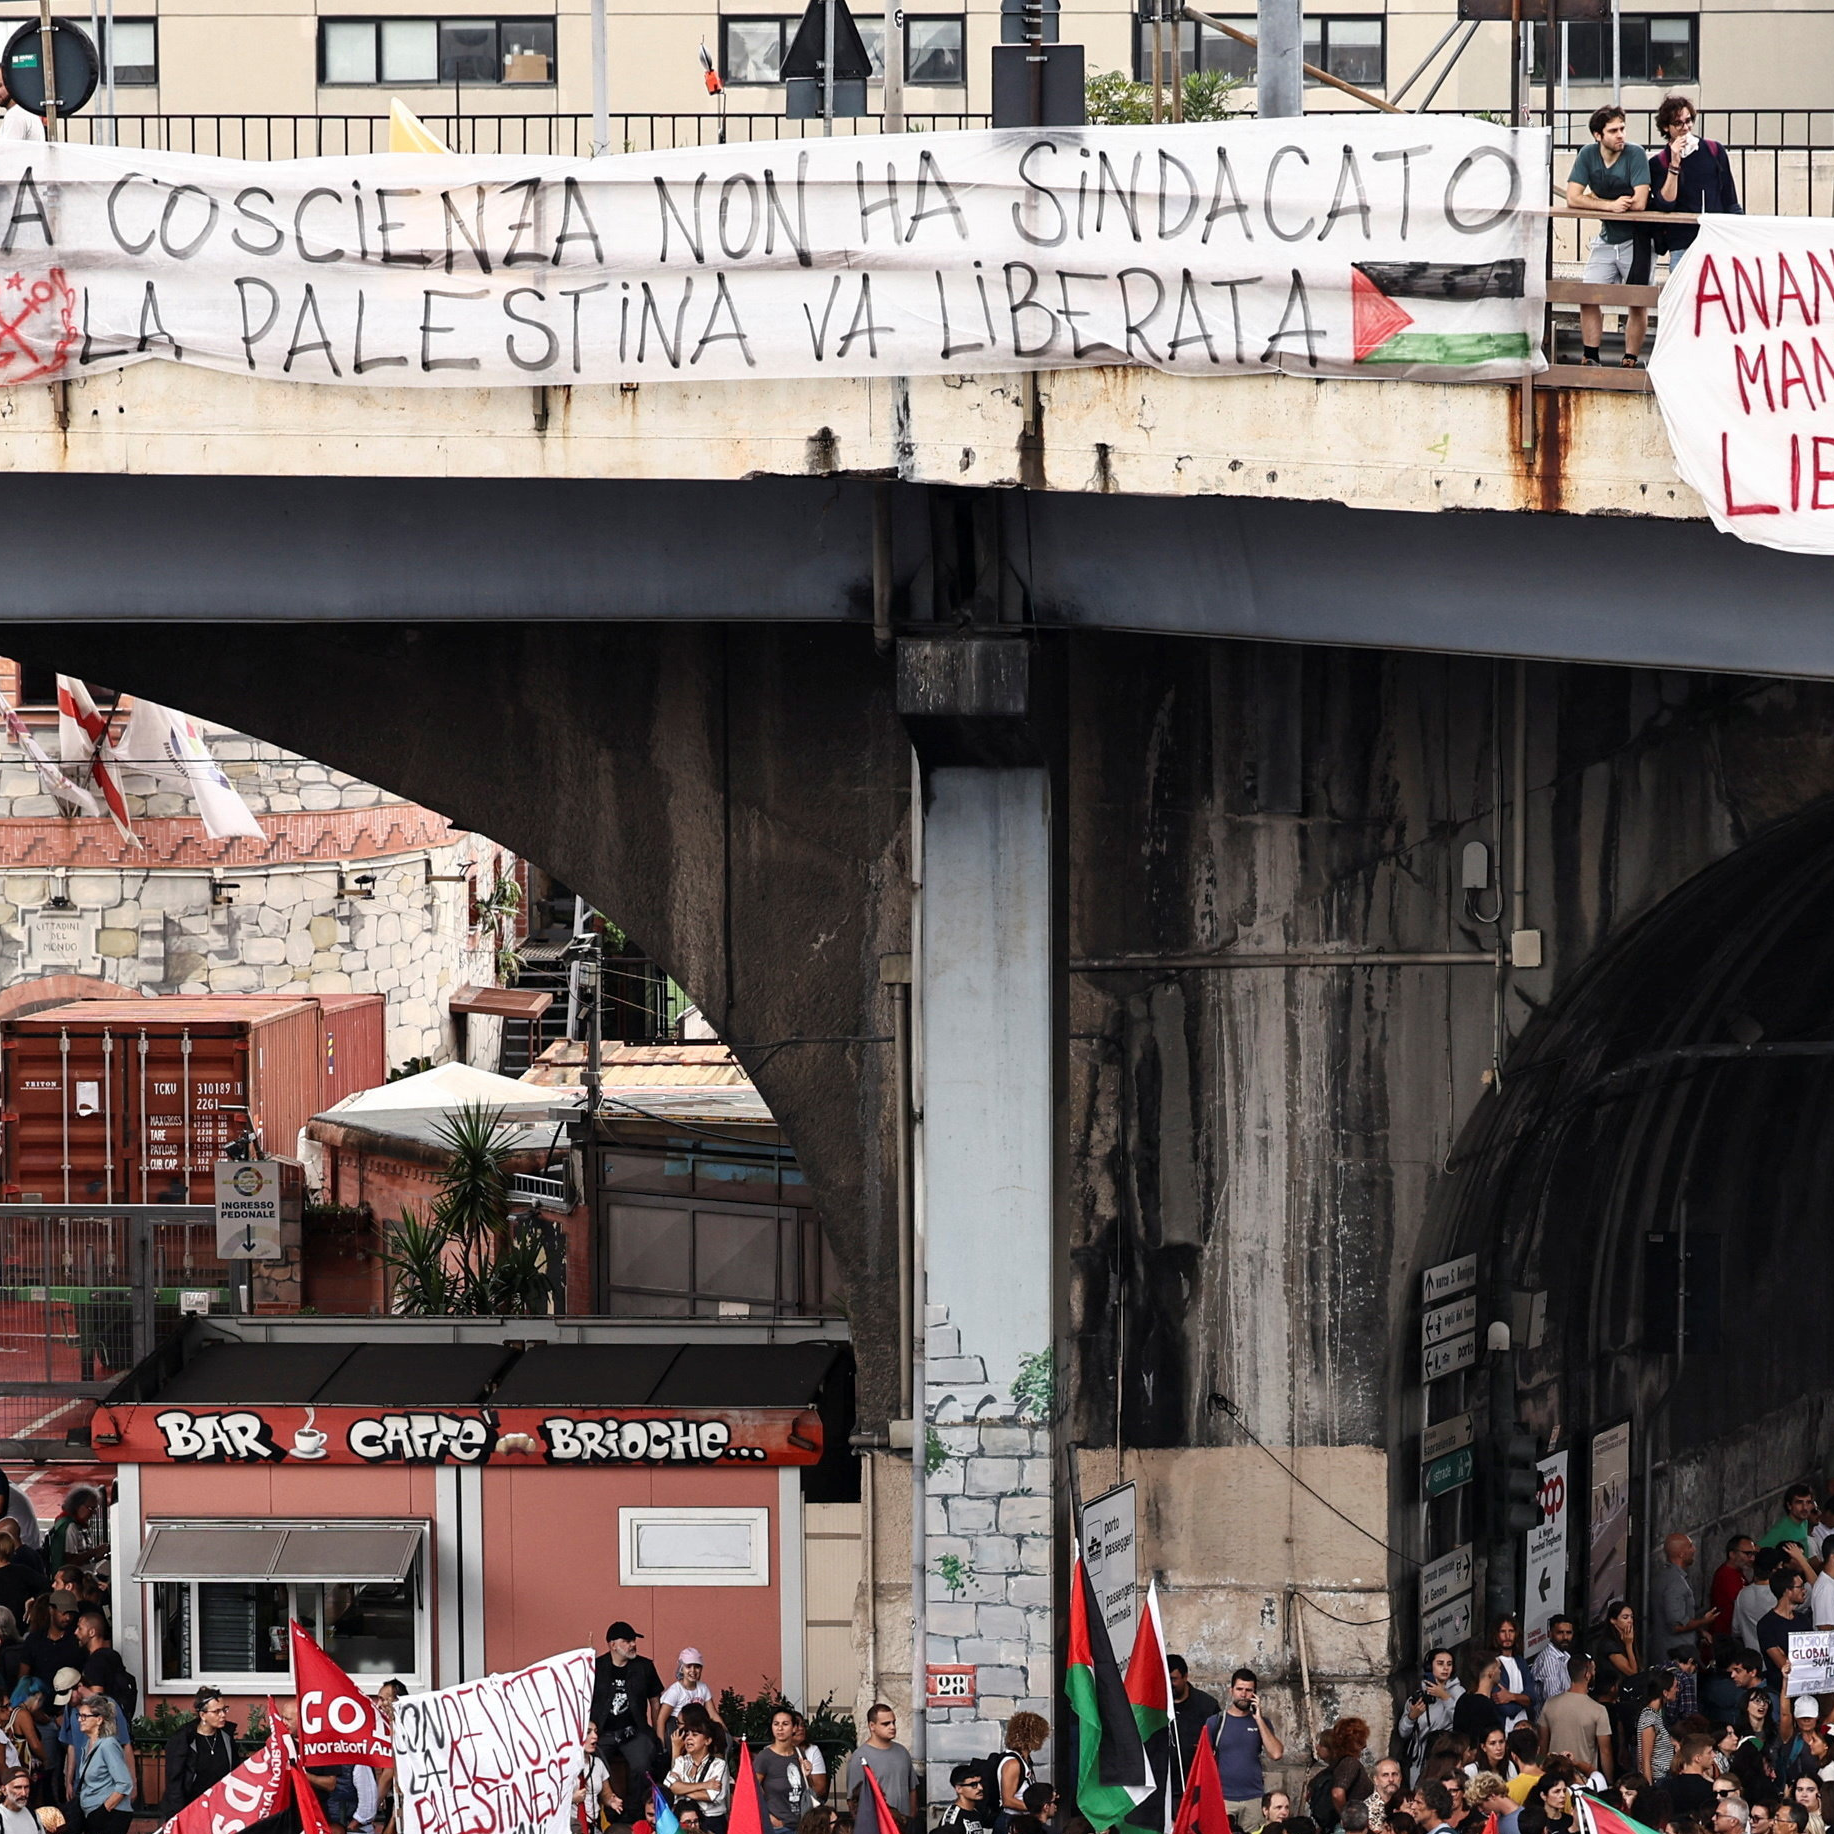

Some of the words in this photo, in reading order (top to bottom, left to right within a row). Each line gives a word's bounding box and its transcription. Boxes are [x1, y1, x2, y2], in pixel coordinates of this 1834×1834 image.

[105, 170, 605, 276] COSCIENZA
[652, 149, 817, 269] NON
[854, 148, 970, 248] HA
[77, 279, 183, 367] LA
[802, 271, 898, 363] VA
[196, 1082, 234, 1096] 310189
[196, 1097, 219, 1111] 22G1
[149, 1128, 167, 1142] TARE
[220, 1201, 276, 1210] INGRESSO
[220, 1210, 276, 1219] PEDONALE
[1457, 1340, 1474, 1363] porto
[155, 1409, 276, 1463] BAR
[1103, 1515, 1120, 1537] porto
[1104, 1527, 1134, 1561] passeggeri
[1105, 1579, 1136, 1609] passengers
[1429, 1582, 1448, 1598] Genova
[1105, 1604, 1133, 1630] terminals
[1790, 1645, 1830, 1661] GLOBAL
[937, 1675, 966, 1696] 28
[410, 1750, 448, 1795] LA
